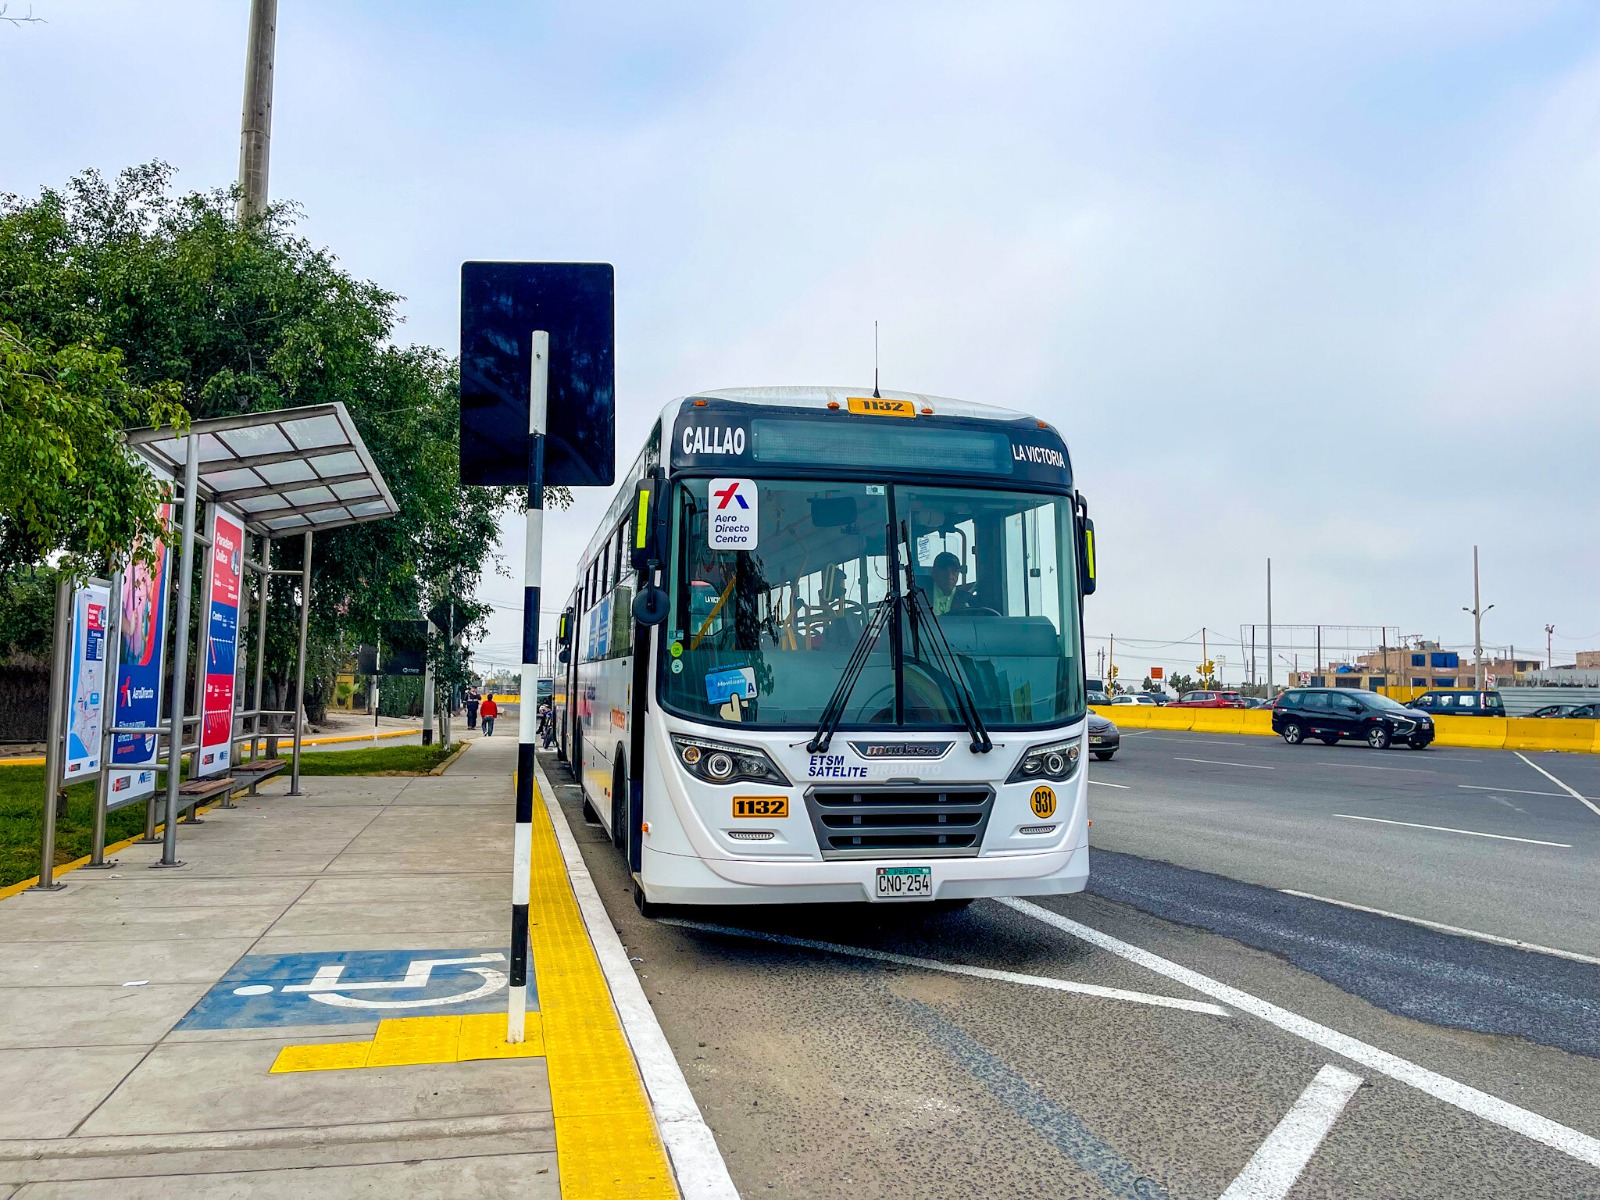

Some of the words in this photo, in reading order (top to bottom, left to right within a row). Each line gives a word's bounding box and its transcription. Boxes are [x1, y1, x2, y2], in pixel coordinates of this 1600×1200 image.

[862, 401, 905, 412] 1132
[682, 426, 746, 455] CALLAO
[1012, 444, 1027, 461] LA
[1026, 445, 1066, 468] VICTORIA
[714, 514, 737, 523] Aero
[715, 524, 750, 533] Directo
[715, 534, 748, 543] Centro
[747, 682, 755, 693] A
[809, 755, 845, 766] ETSM
[808, 766, 868, 777] SATELITE
[736, 800, 785, 814] 1132
[1034, 790, 1053, 813] 931
[879, 874, 929, 892] CNO-254
